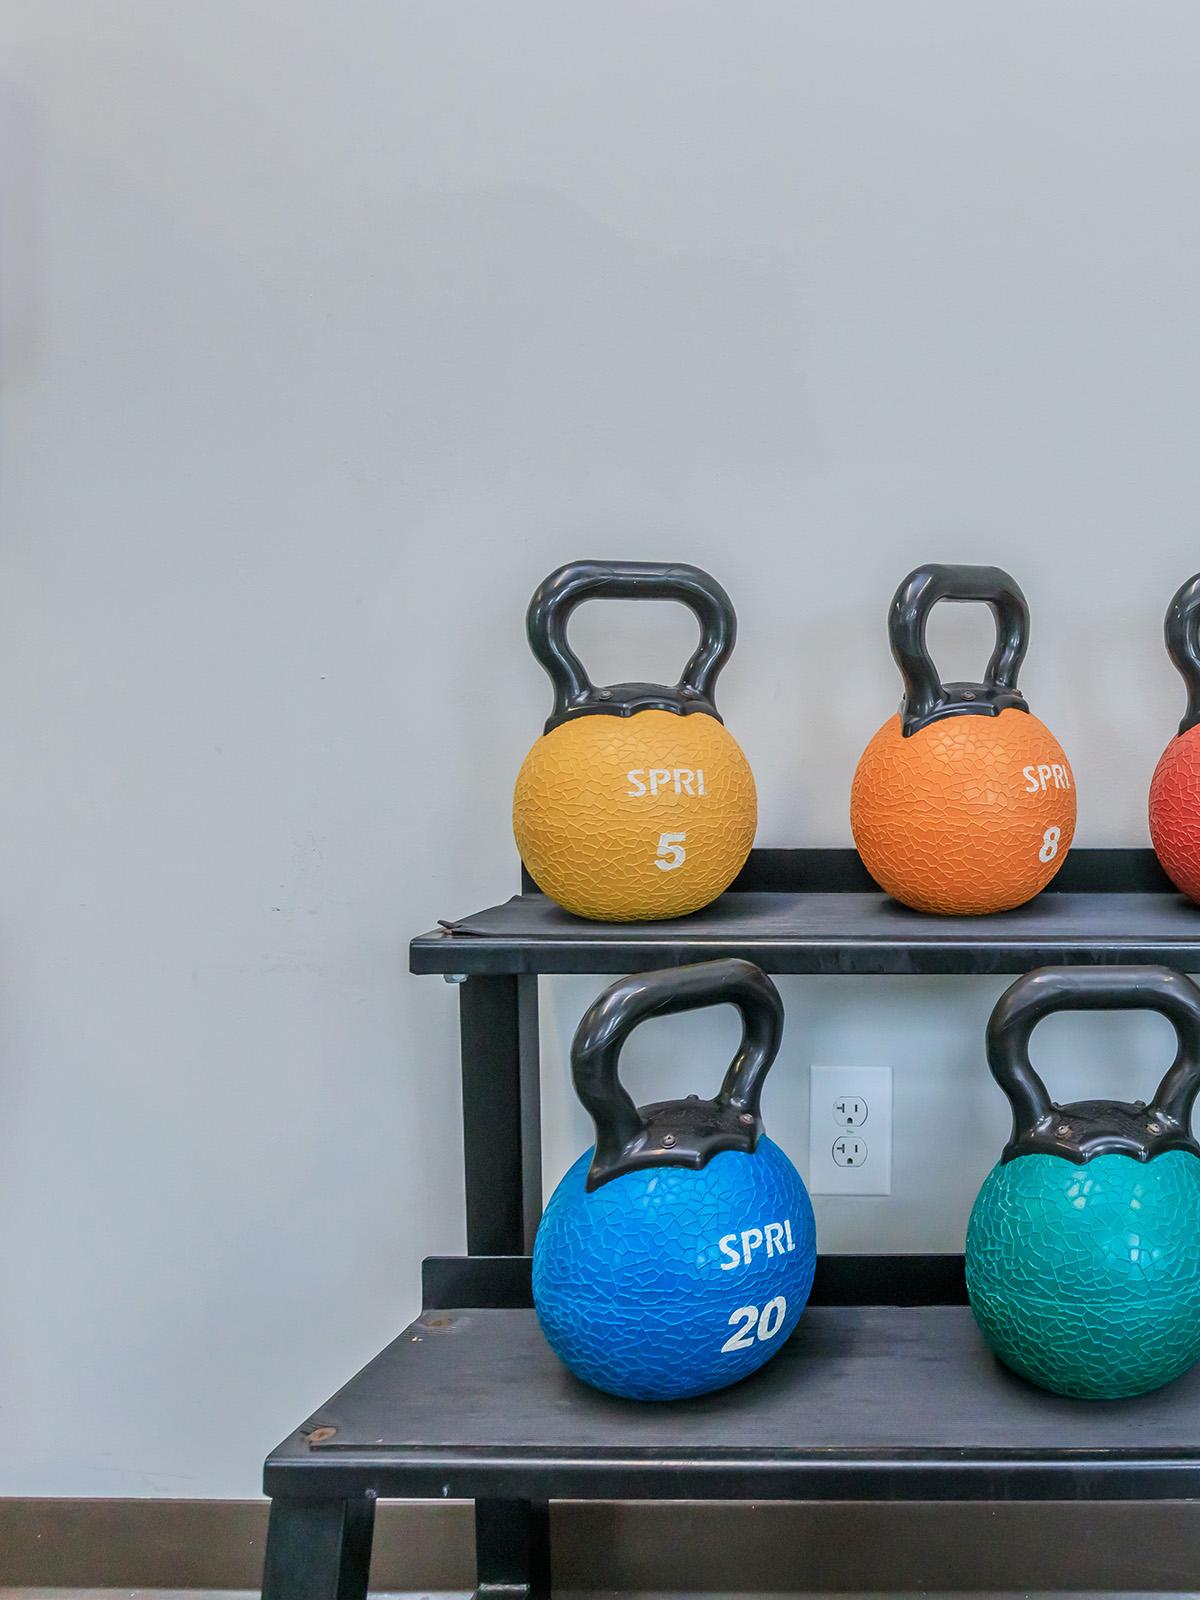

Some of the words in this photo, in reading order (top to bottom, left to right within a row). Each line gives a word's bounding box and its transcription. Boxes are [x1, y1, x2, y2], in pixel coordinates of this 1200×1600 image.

[627, 768, 705, 797] SPRI
[1023, 764, 1071, 793] SPRI
[655, 832, 687, 871] 5
[1039, 826, 1061, 863] 8
[719, 1220, 796, 1270] SPRI
[720, 1296, 787, 1352] 20
